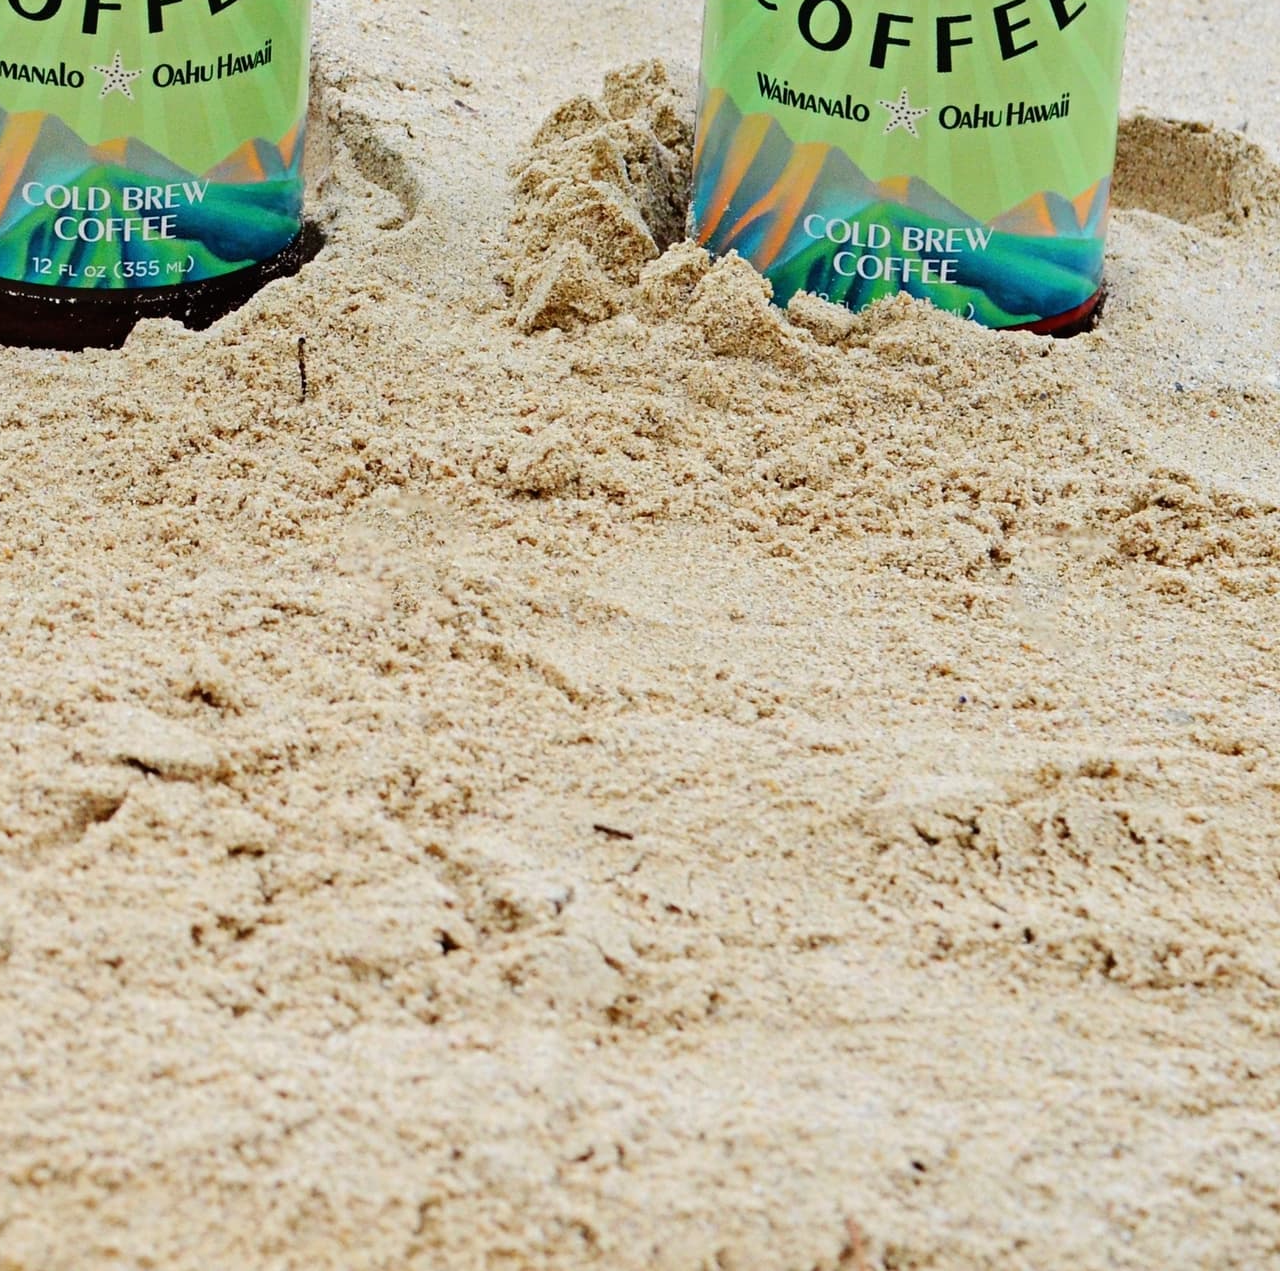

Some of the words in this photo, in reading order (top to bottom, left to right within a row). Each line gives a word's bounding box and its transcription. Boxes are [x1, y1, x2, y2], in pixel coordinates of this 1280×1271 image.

[22, 182, 111, 211] COLD
[123, 178, 210, 211] BREW
[54, 214, 177, 242] COFFEE
[803, 214, 891, 249] COLD
[902, 226, 995, 253] BREW
[32, 257, 52, 274] 12
[59, 264, 77, 277] FL
[84, 265, 106, 278] OZ
[114, 260, 160, 279] (355
[167, 255, 194, 273] ML)
[833, 251, 959, 284] COFFEE
